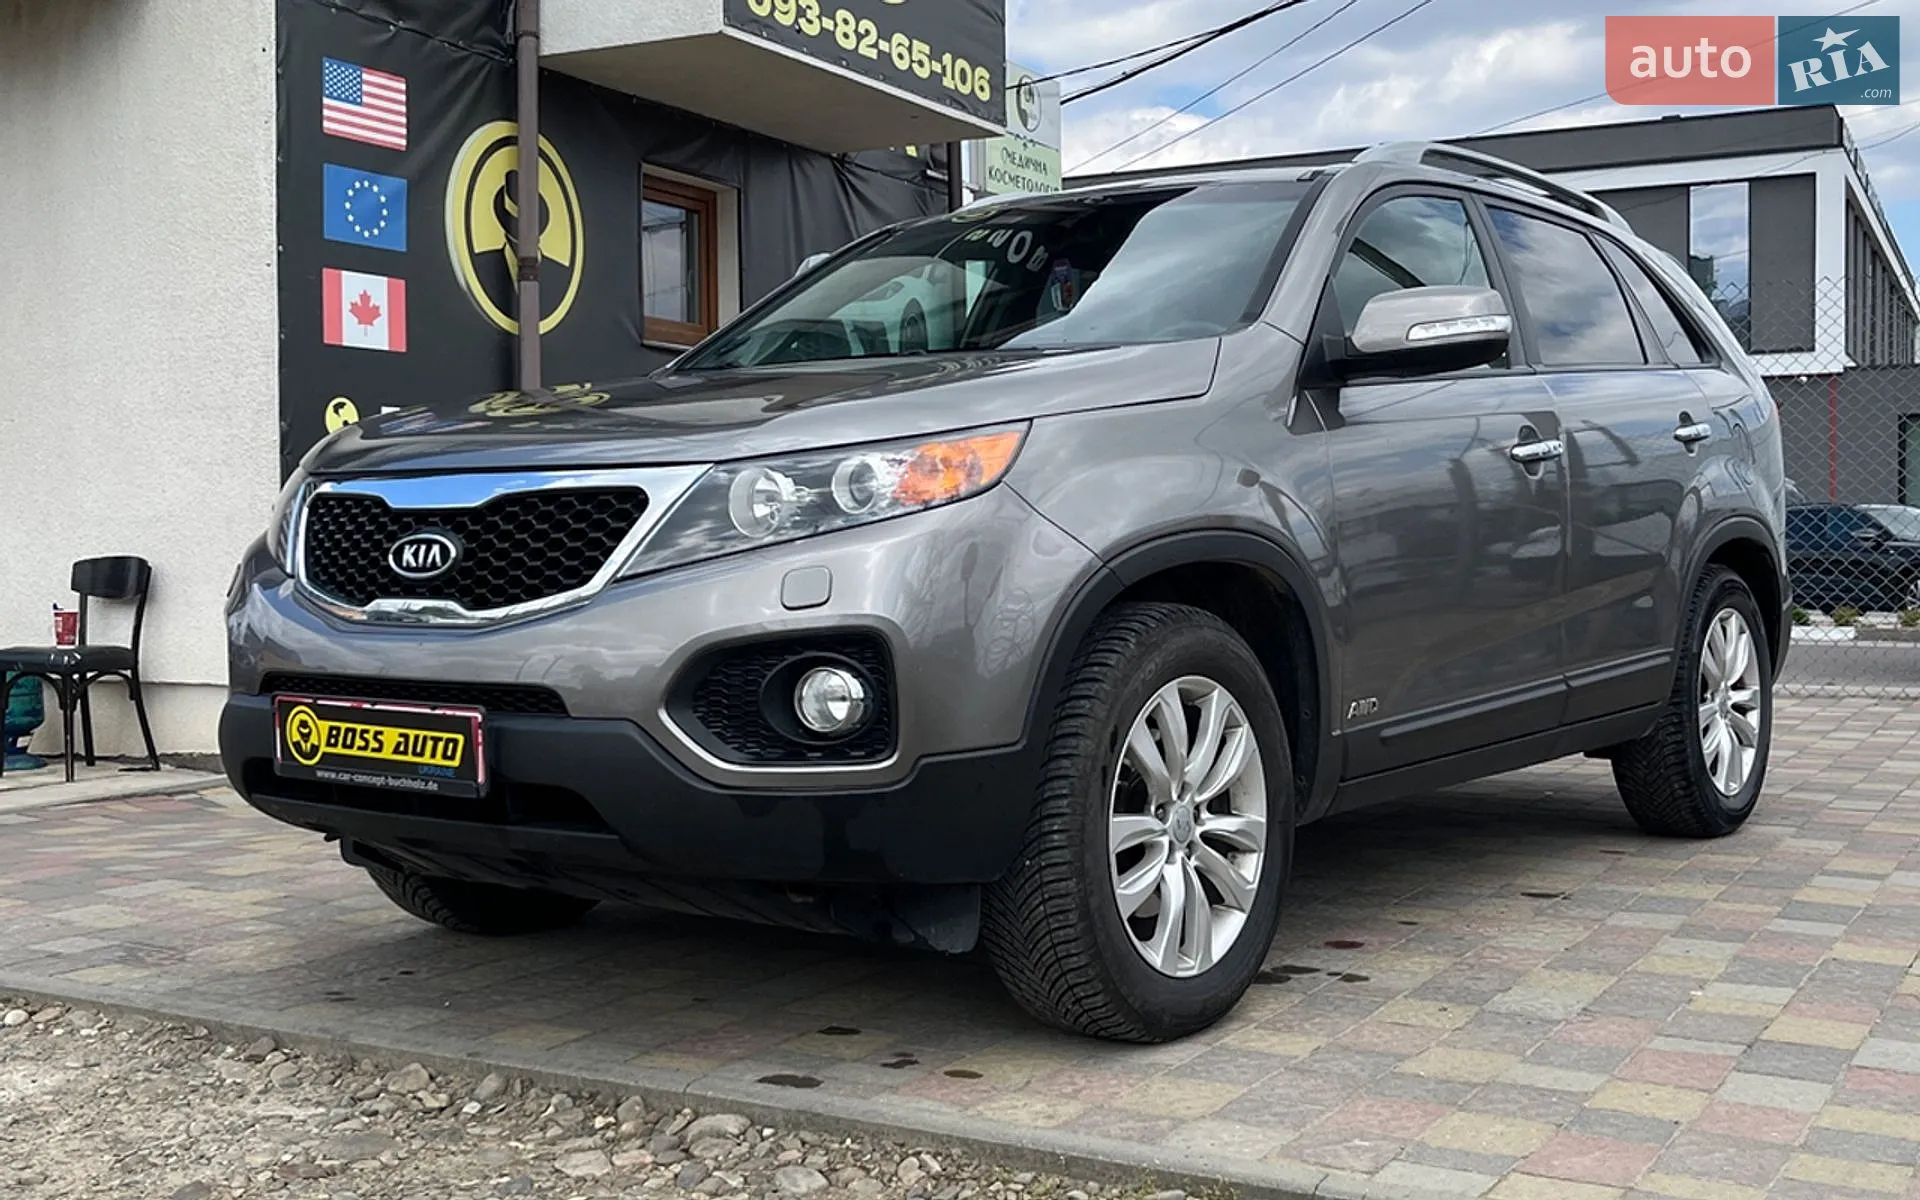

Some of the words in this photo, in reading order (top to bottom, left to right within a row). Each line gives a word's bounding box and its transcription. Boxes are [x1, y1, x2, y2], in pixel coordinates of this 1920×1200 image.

[402, 544, 442, 568] KIA
[326, 725, 385, 753] BOSS
[392, 732, 460, 762] AUTO
